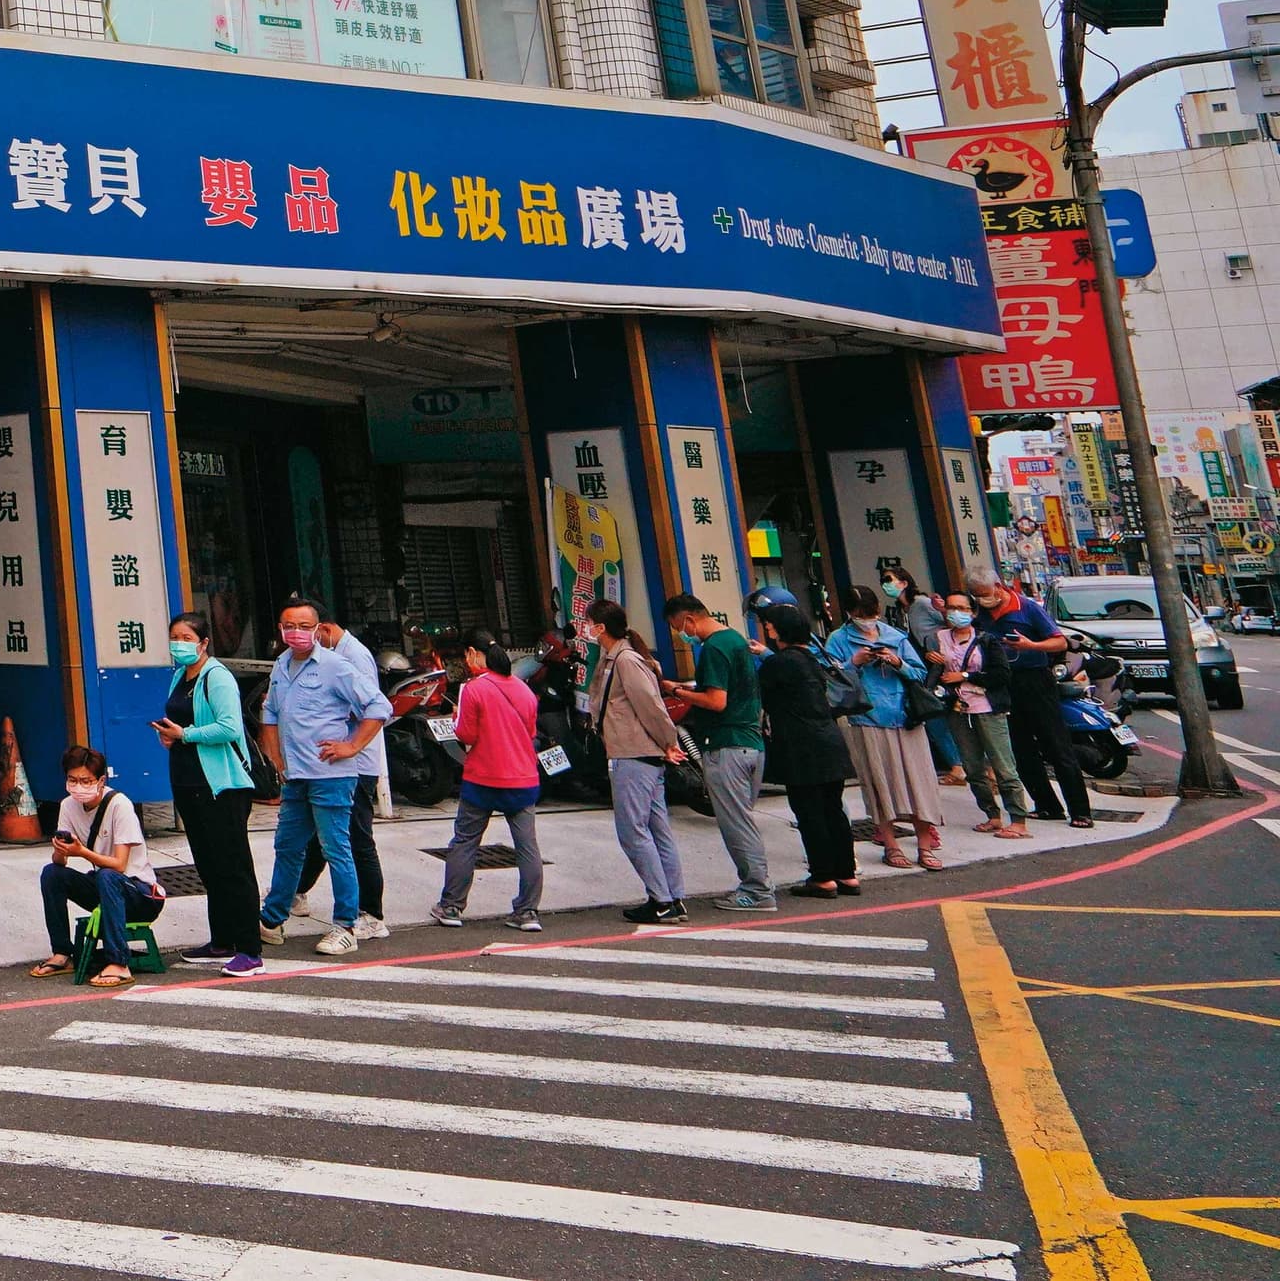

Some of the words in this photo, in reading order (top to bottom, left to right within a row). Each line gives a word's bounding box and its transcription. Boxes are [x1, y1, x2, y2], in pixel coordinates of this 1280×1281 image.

[198, 155, 340, 235] 嬰品
[389, 169, 687, 254] 化妝品廣場
[739, 208, 774, 248] Drug
[776, 219, 806, 250] store
[809, 222, 860, 262] Cosmetic
[861, 235, 890, 275] Baby
[892, 251, 916, 275] care
[918, 251, 948, 281] center
[951, 256, 979, 287] Milk
[99, 423, 147, 655] 育嬰諮詢
